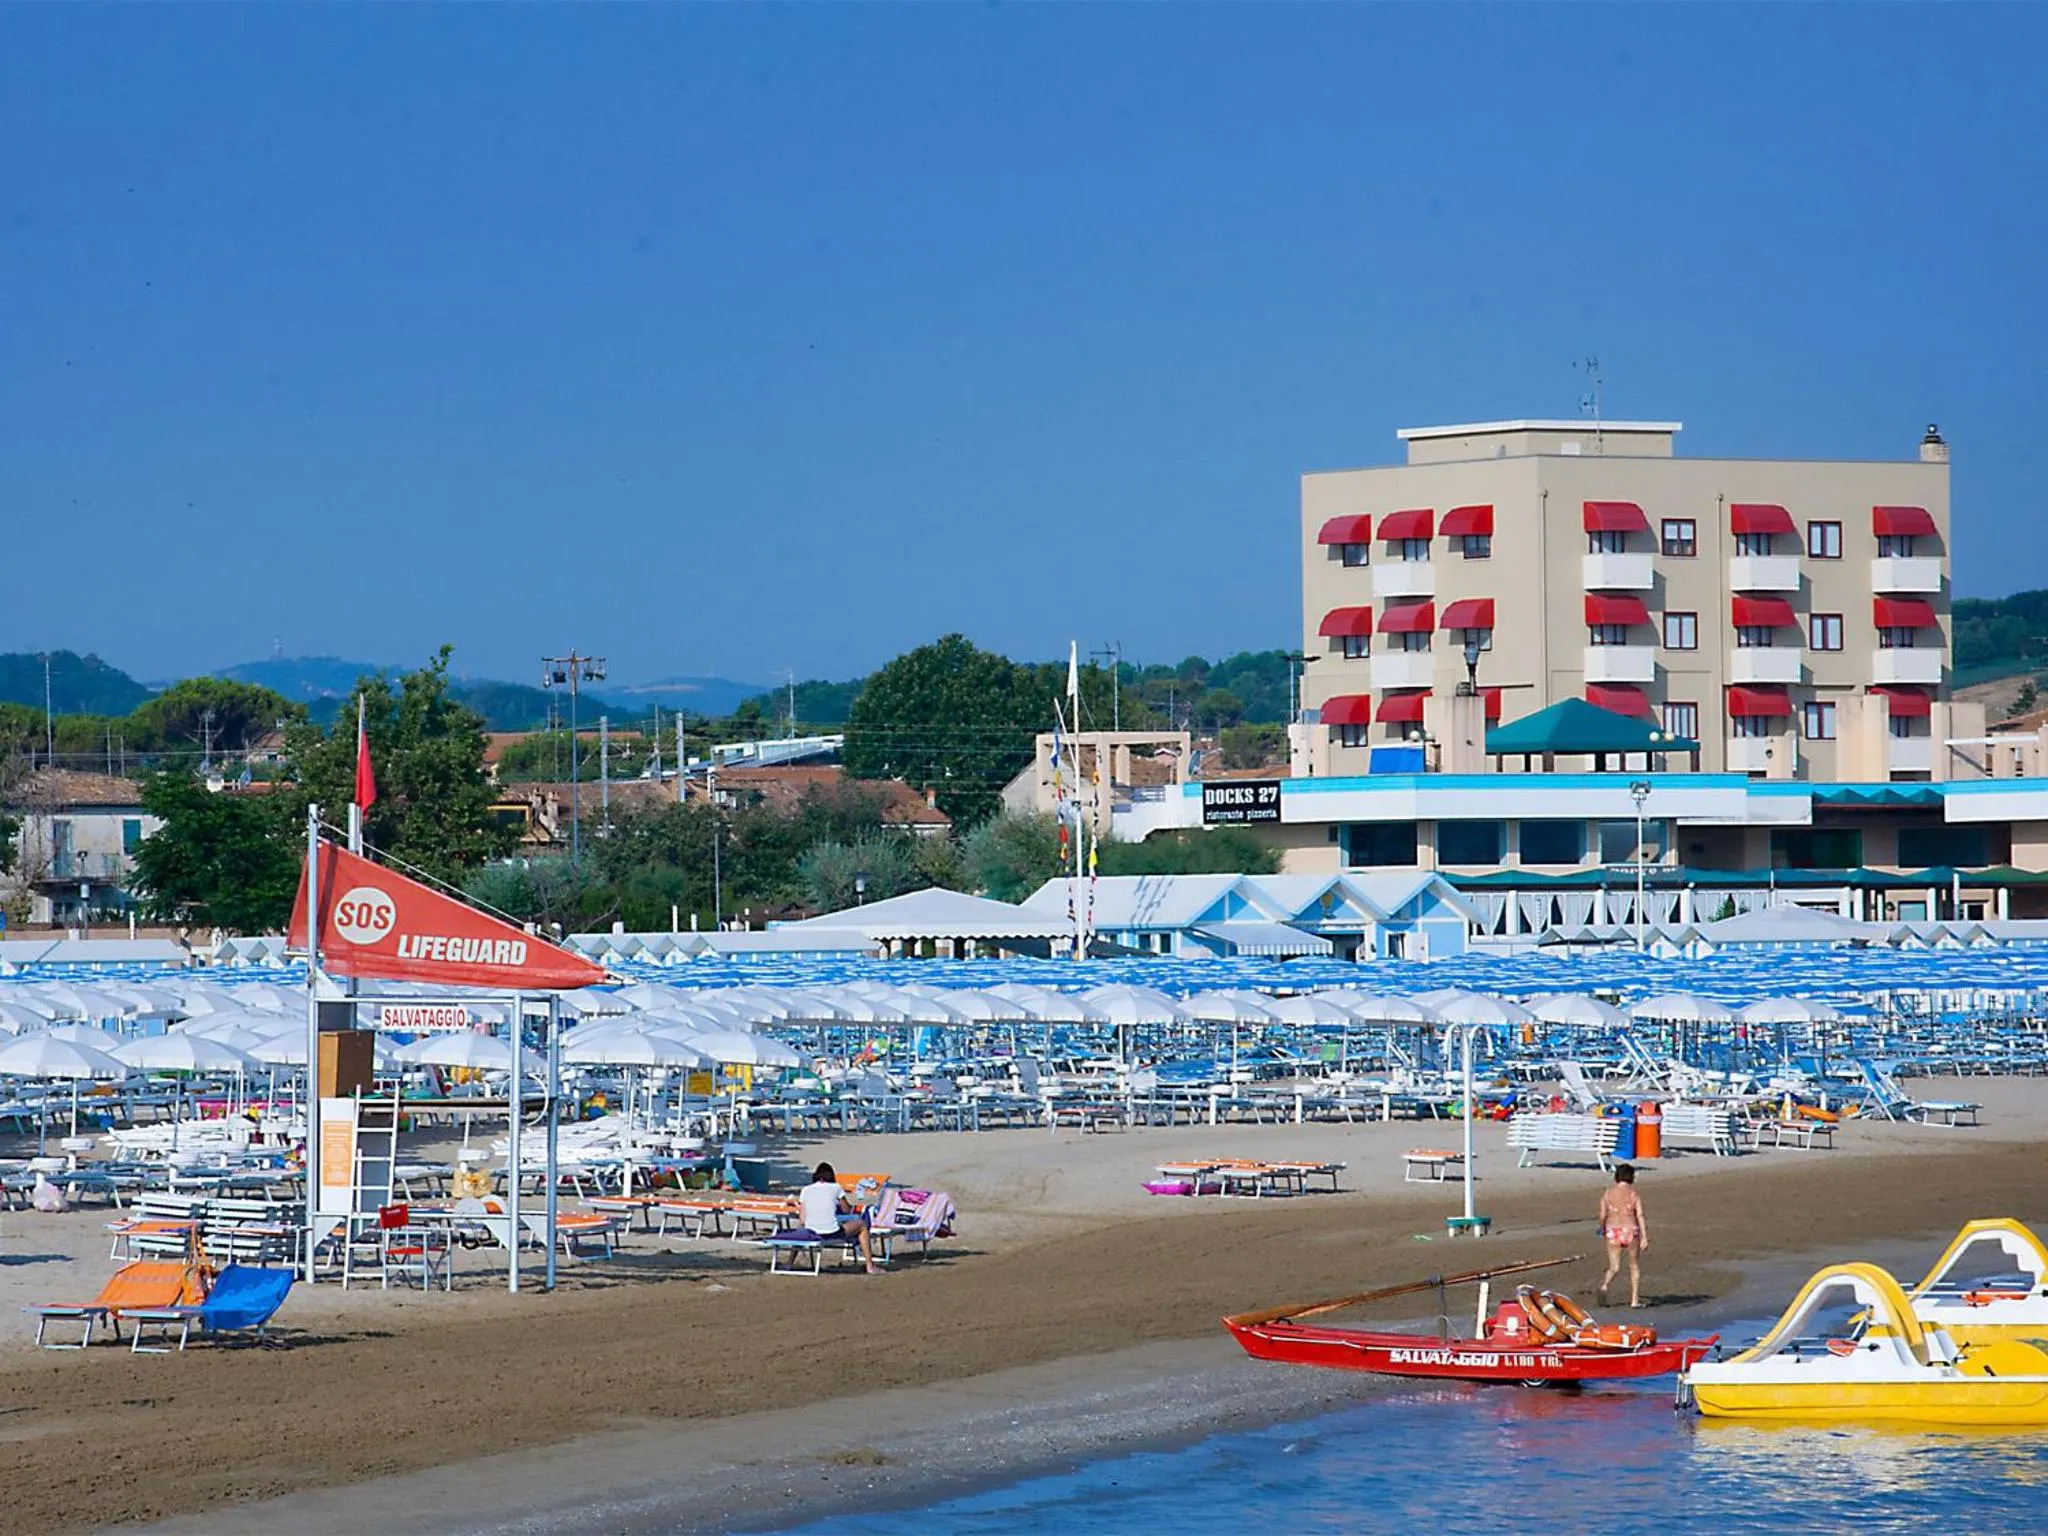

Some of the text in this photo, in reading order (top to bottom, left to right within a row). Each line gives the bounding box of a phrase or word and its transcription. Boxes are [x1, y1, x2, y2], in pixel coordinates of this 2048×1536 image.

[1205, 786, 1278, 805] DOCKS 27
[1206, 808, 1278, 821] ristorante pizzeria
[337, 901, 392, 929] SOS
[398, 934, 527, 966] LIFEGUARD
[384, 1008, 465, 1026] SALVATAGGIO
[1389, 1349, 1498, 1367] SALVATAGGIO
